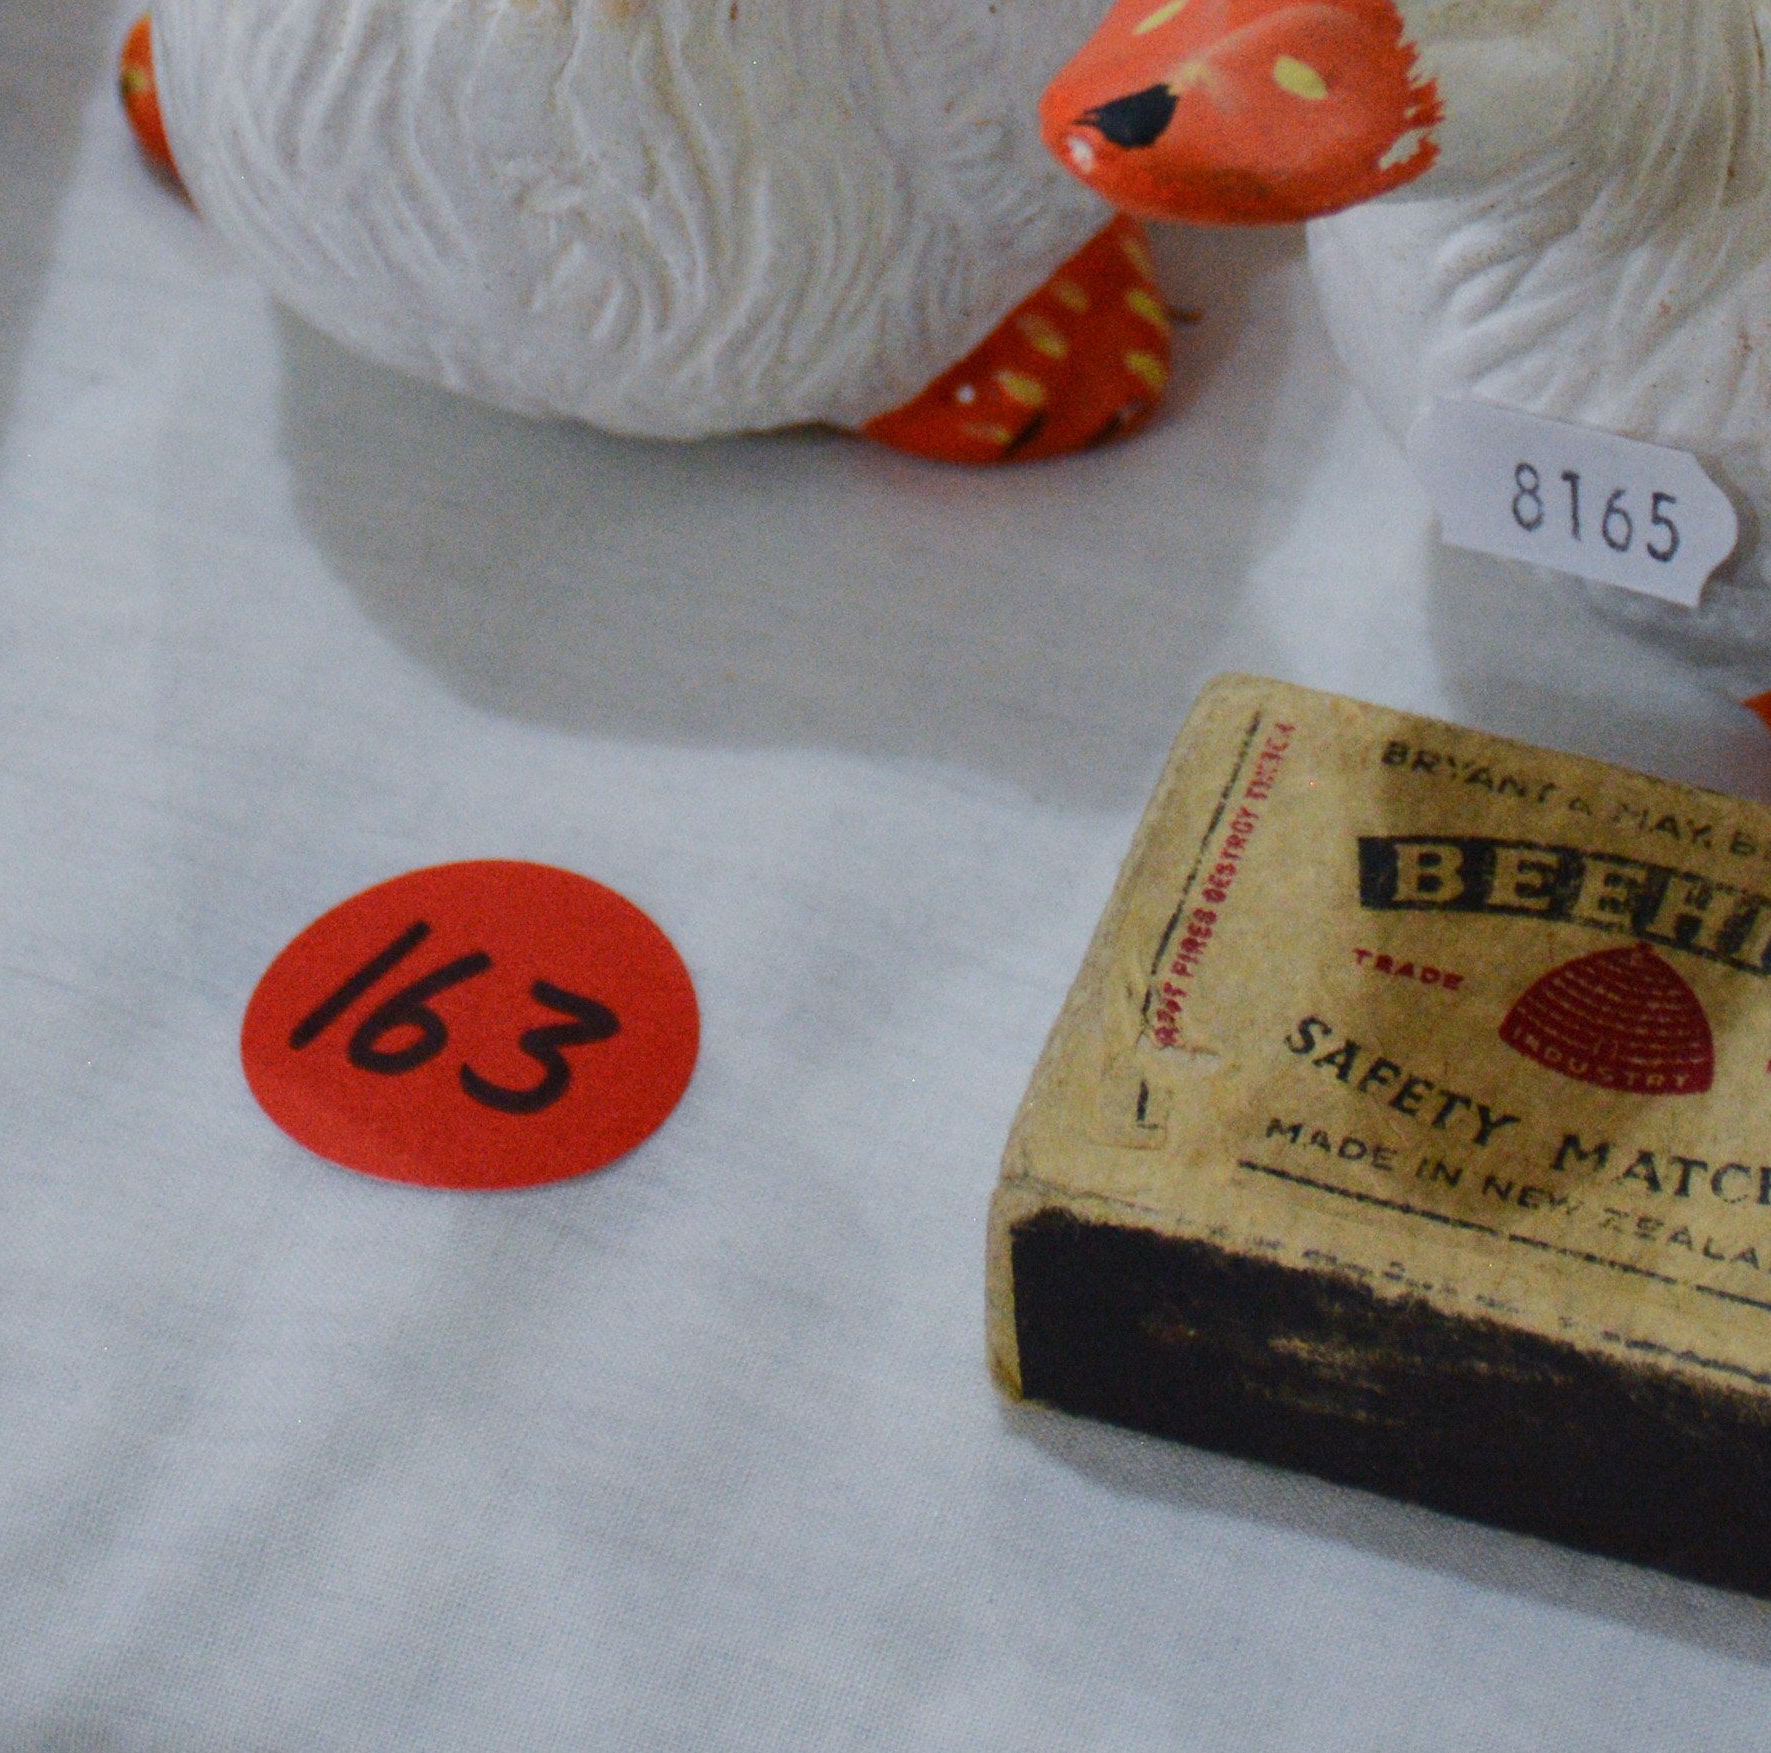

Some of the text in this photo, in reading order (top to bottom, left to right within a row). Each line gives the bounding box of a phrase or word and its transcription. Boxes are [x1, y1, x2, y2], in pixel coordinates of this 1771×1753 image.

[1512, 462, 1680, 563] 8165
[1381, 740, 1558, 803] BRYANT
[1171, 907, 1218, 978] FIRES
[1201, 804, 1260, 904] DESTROY
[288, 920, 622, 1116] 163
[1353, 947, 1465, 991] TRADE
[1283, 1015, 1522, 1147] SAFETY
[1512, 1024, 1691, 1089] INDUSTRY
[1265, 1116, 1398, 1172] MADE
[1415, 1156, 1464, 1188] IN
[1481, 1173, 1585, 1216] NEW
